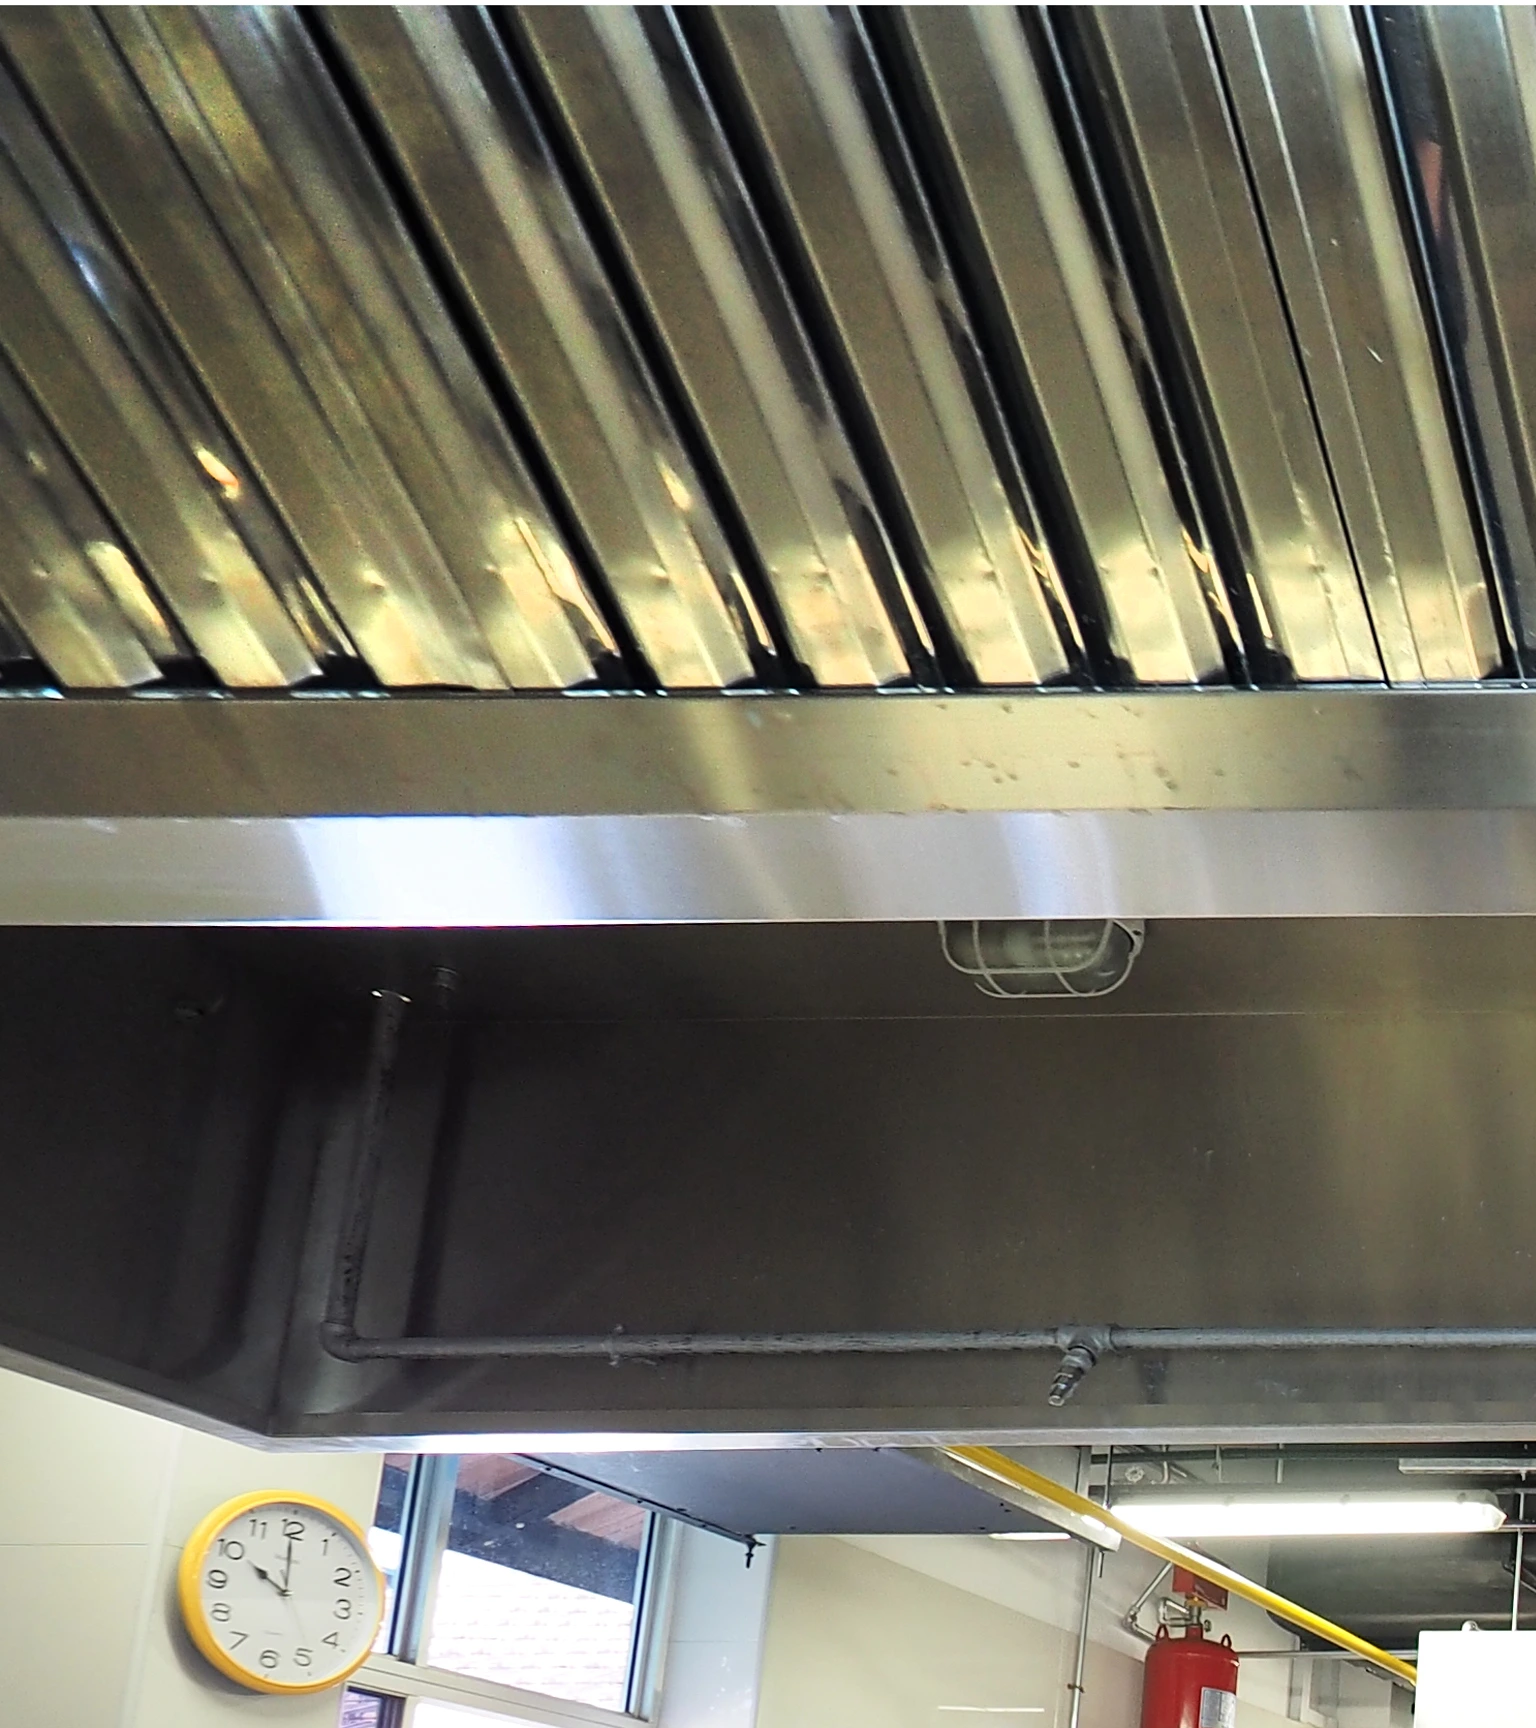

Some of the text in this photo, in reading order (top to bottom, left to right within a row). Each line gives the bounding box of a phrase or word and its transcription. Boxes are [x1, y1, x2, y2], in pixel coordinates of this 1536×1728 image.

[250, 1519, 267, 1540] 11
[281, 1518, 305, 1541] 12
[217, 1538, 245, 1560] 10
[321, 1538, 329, 1556] 1
[206, 1569, 228, 1589] 9
[333, 1567, 351, 1587] 2
[211, 1602, 231, 1622] 8
[333, 1599, 351, 1619] 3
[230, 1631, 249, 1650] 7
[321, 1631, 339, 1649] 4
[259, 1649, 280, 1669] 6
[293, 1648, 313, 1667] 5
